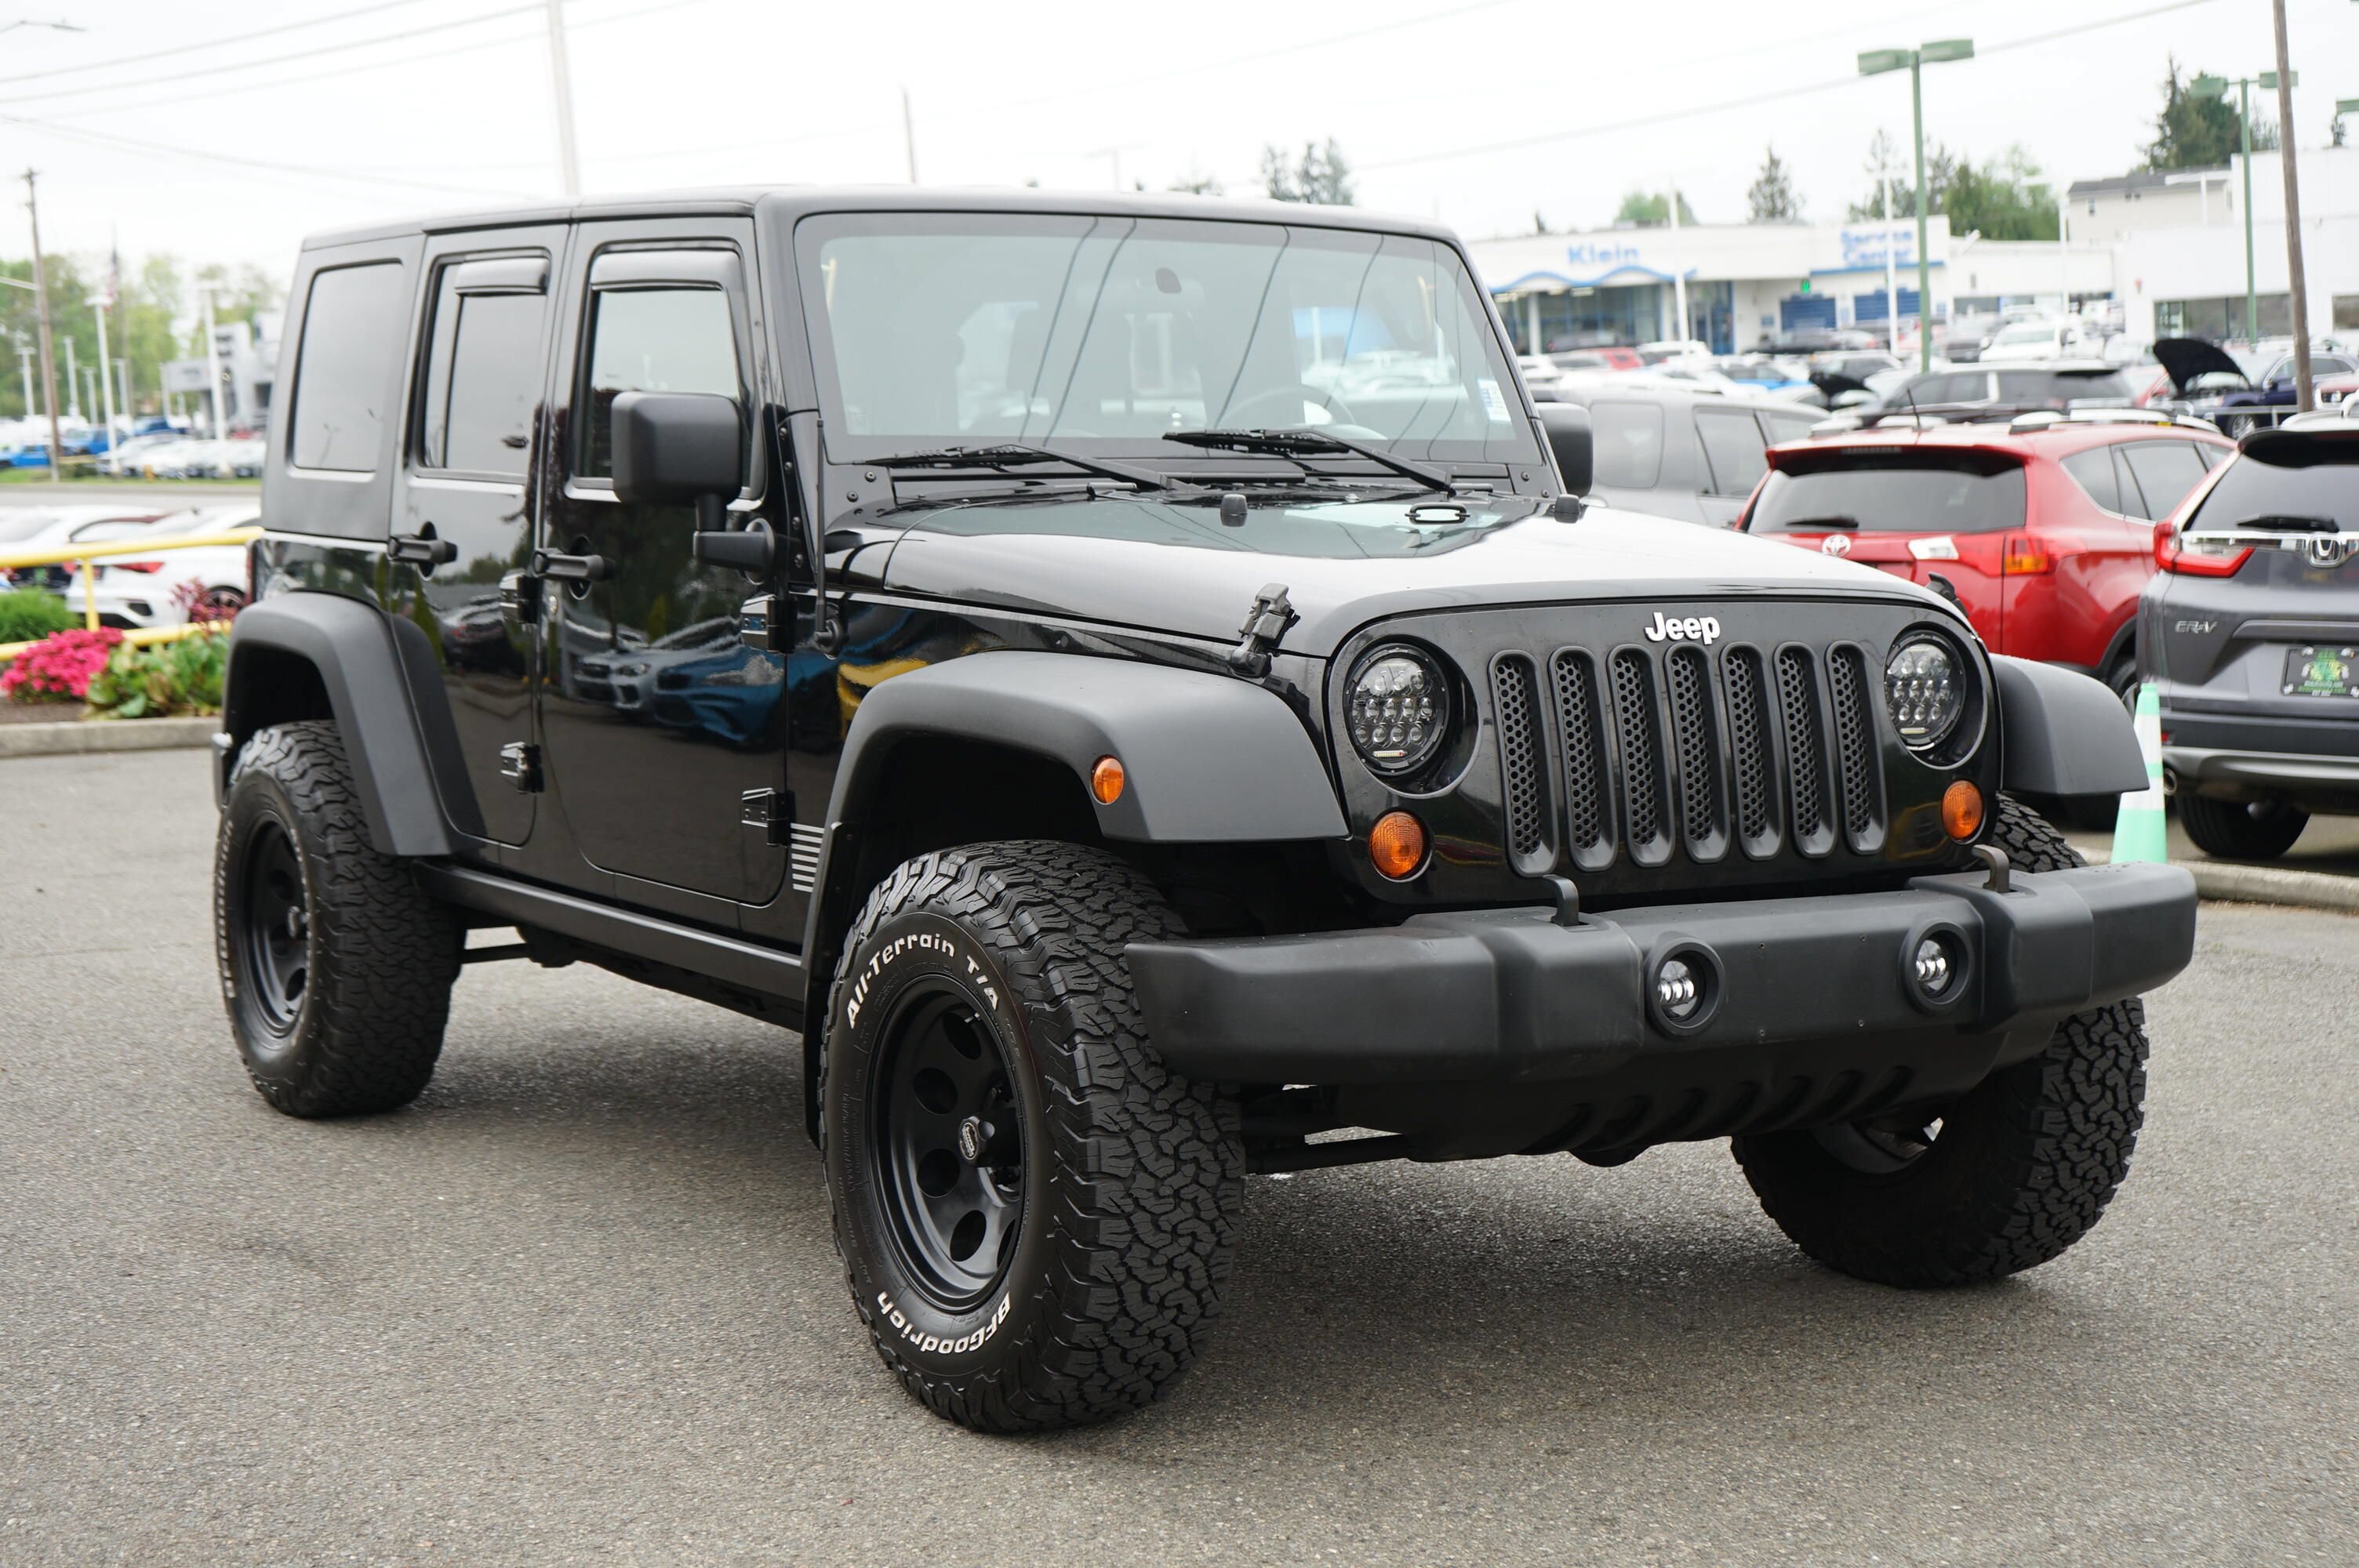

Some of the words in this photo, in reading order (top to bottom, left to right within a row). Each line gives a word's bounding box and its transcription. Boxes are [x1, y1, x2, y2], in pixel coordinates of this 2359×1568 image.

[1568, 244, 1639, 264] Klein
[1841, 230, 1913, 246] Servce
[1645, 612, 1721, 644] Jeep
[847, 933, 955, 1029] All-Terrain
[877, 1290, 1012, 1355] BFGoodrich
